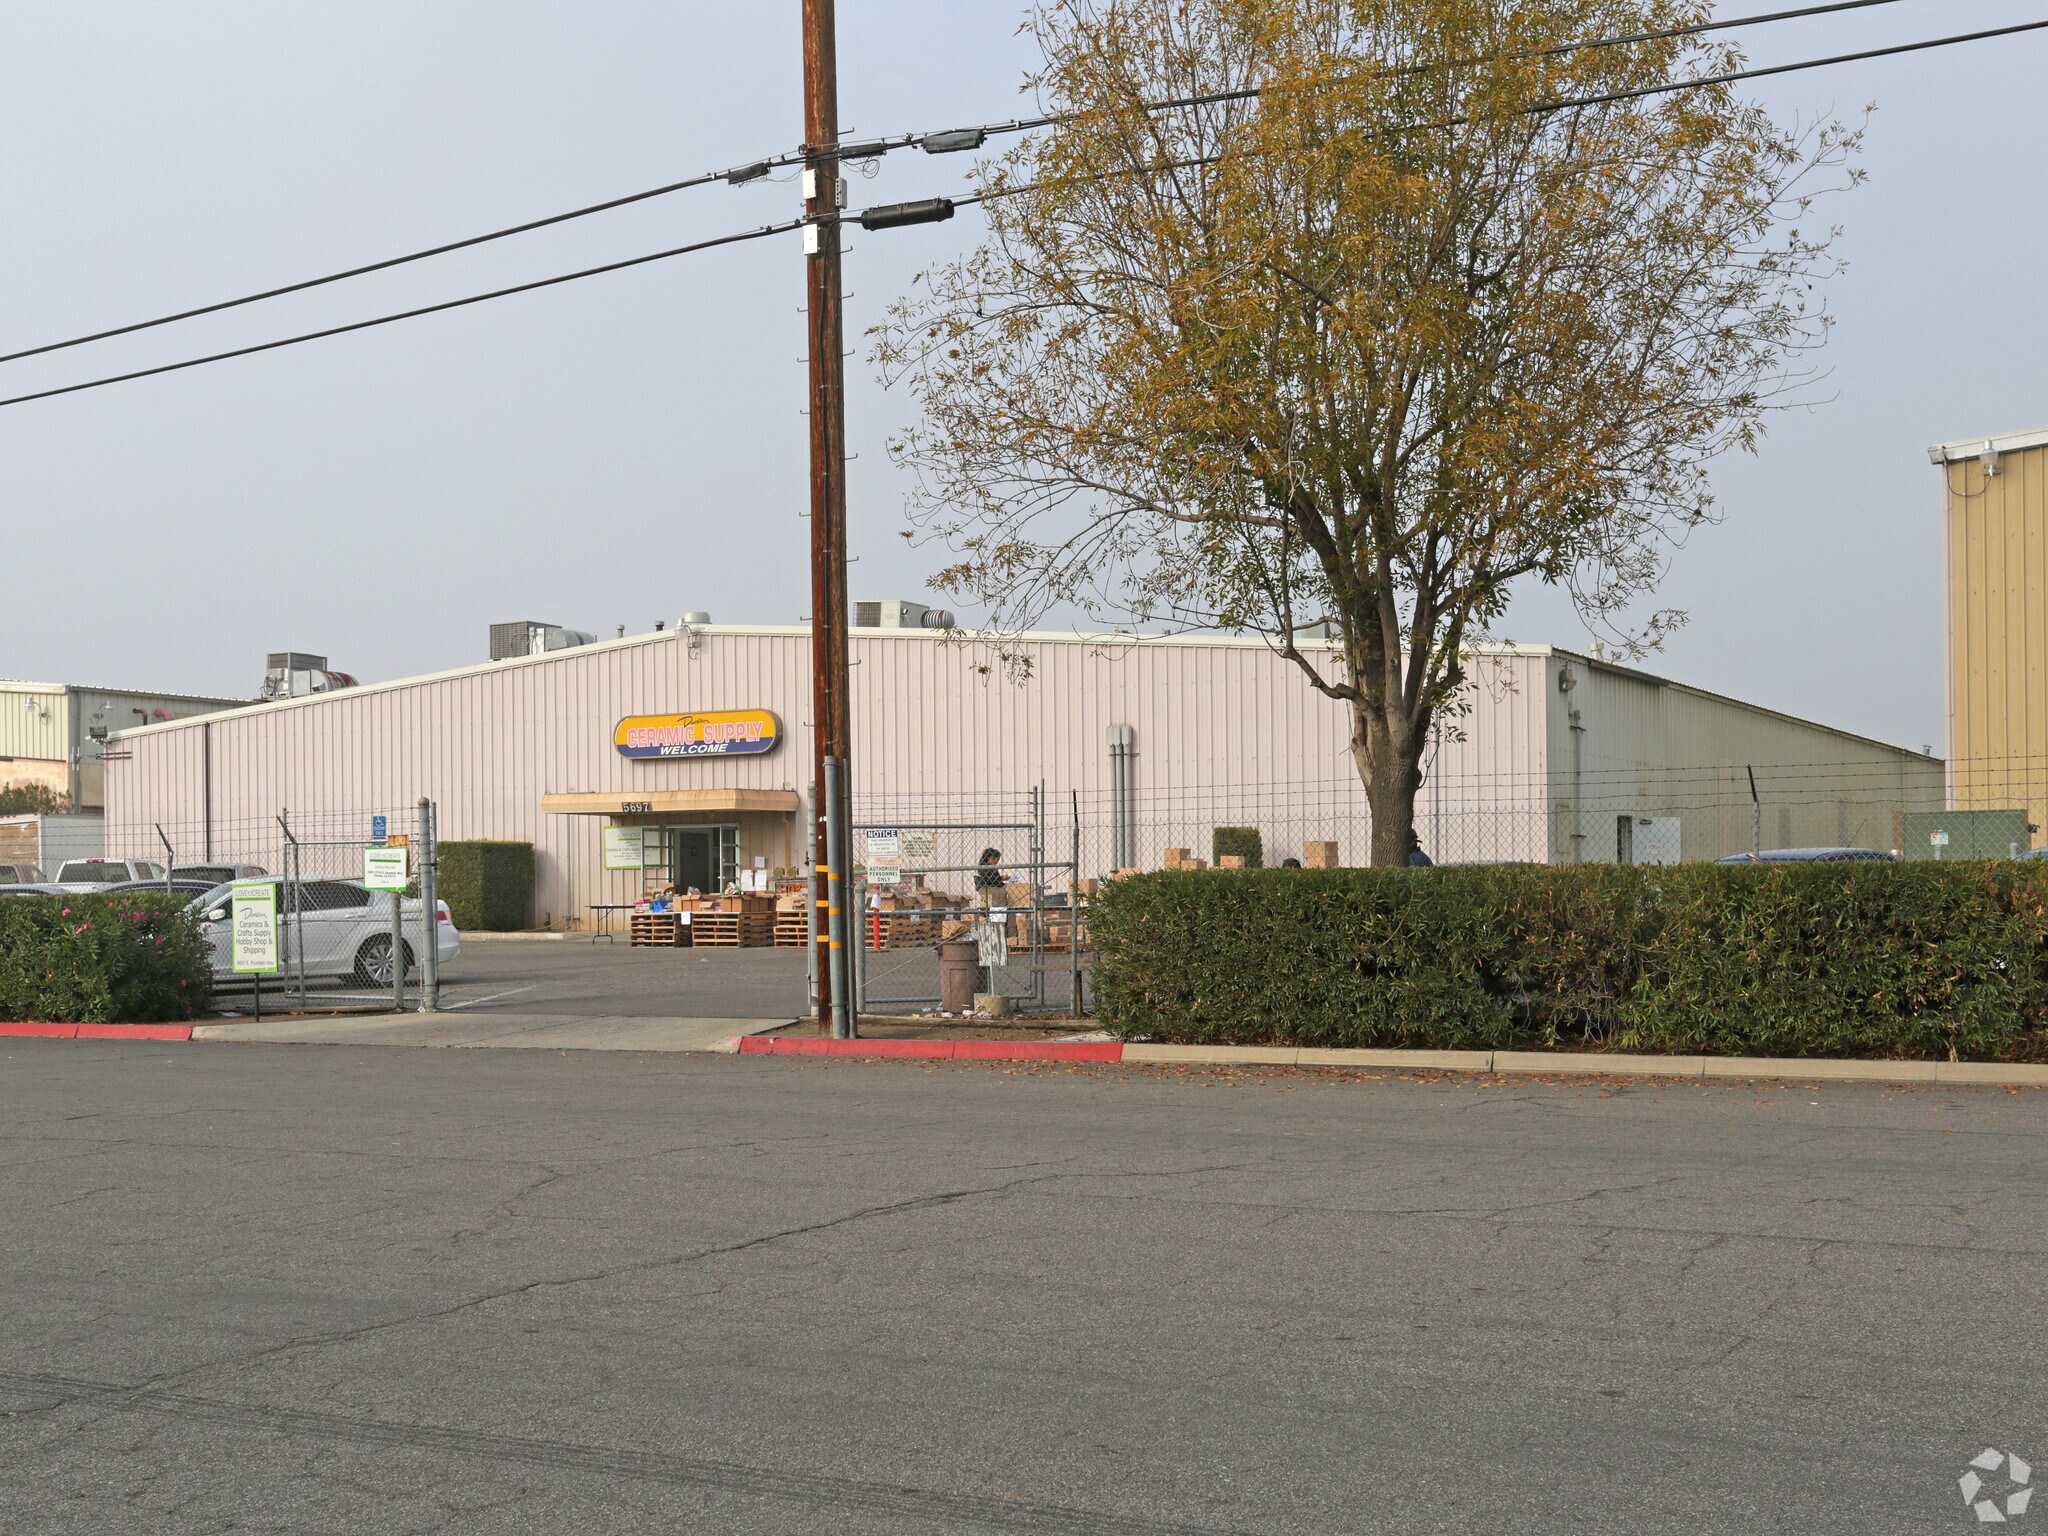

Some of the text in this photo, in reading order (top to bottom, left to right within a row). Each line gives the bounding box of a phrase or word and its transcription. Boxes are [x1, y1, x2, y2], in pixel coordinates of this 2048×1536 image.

[627, 721, 764, 748] CERAMIC SUPPLY
[660, 743, 729, 756] WELCOME
[623, 802, 649, 812] 5697
[239, 920, 269, 928] Ceramics &
[253, 929, 271, 937] Supply
[253, 937, 267, 946] Shop
[243, 946, 266, 955] Shipping
